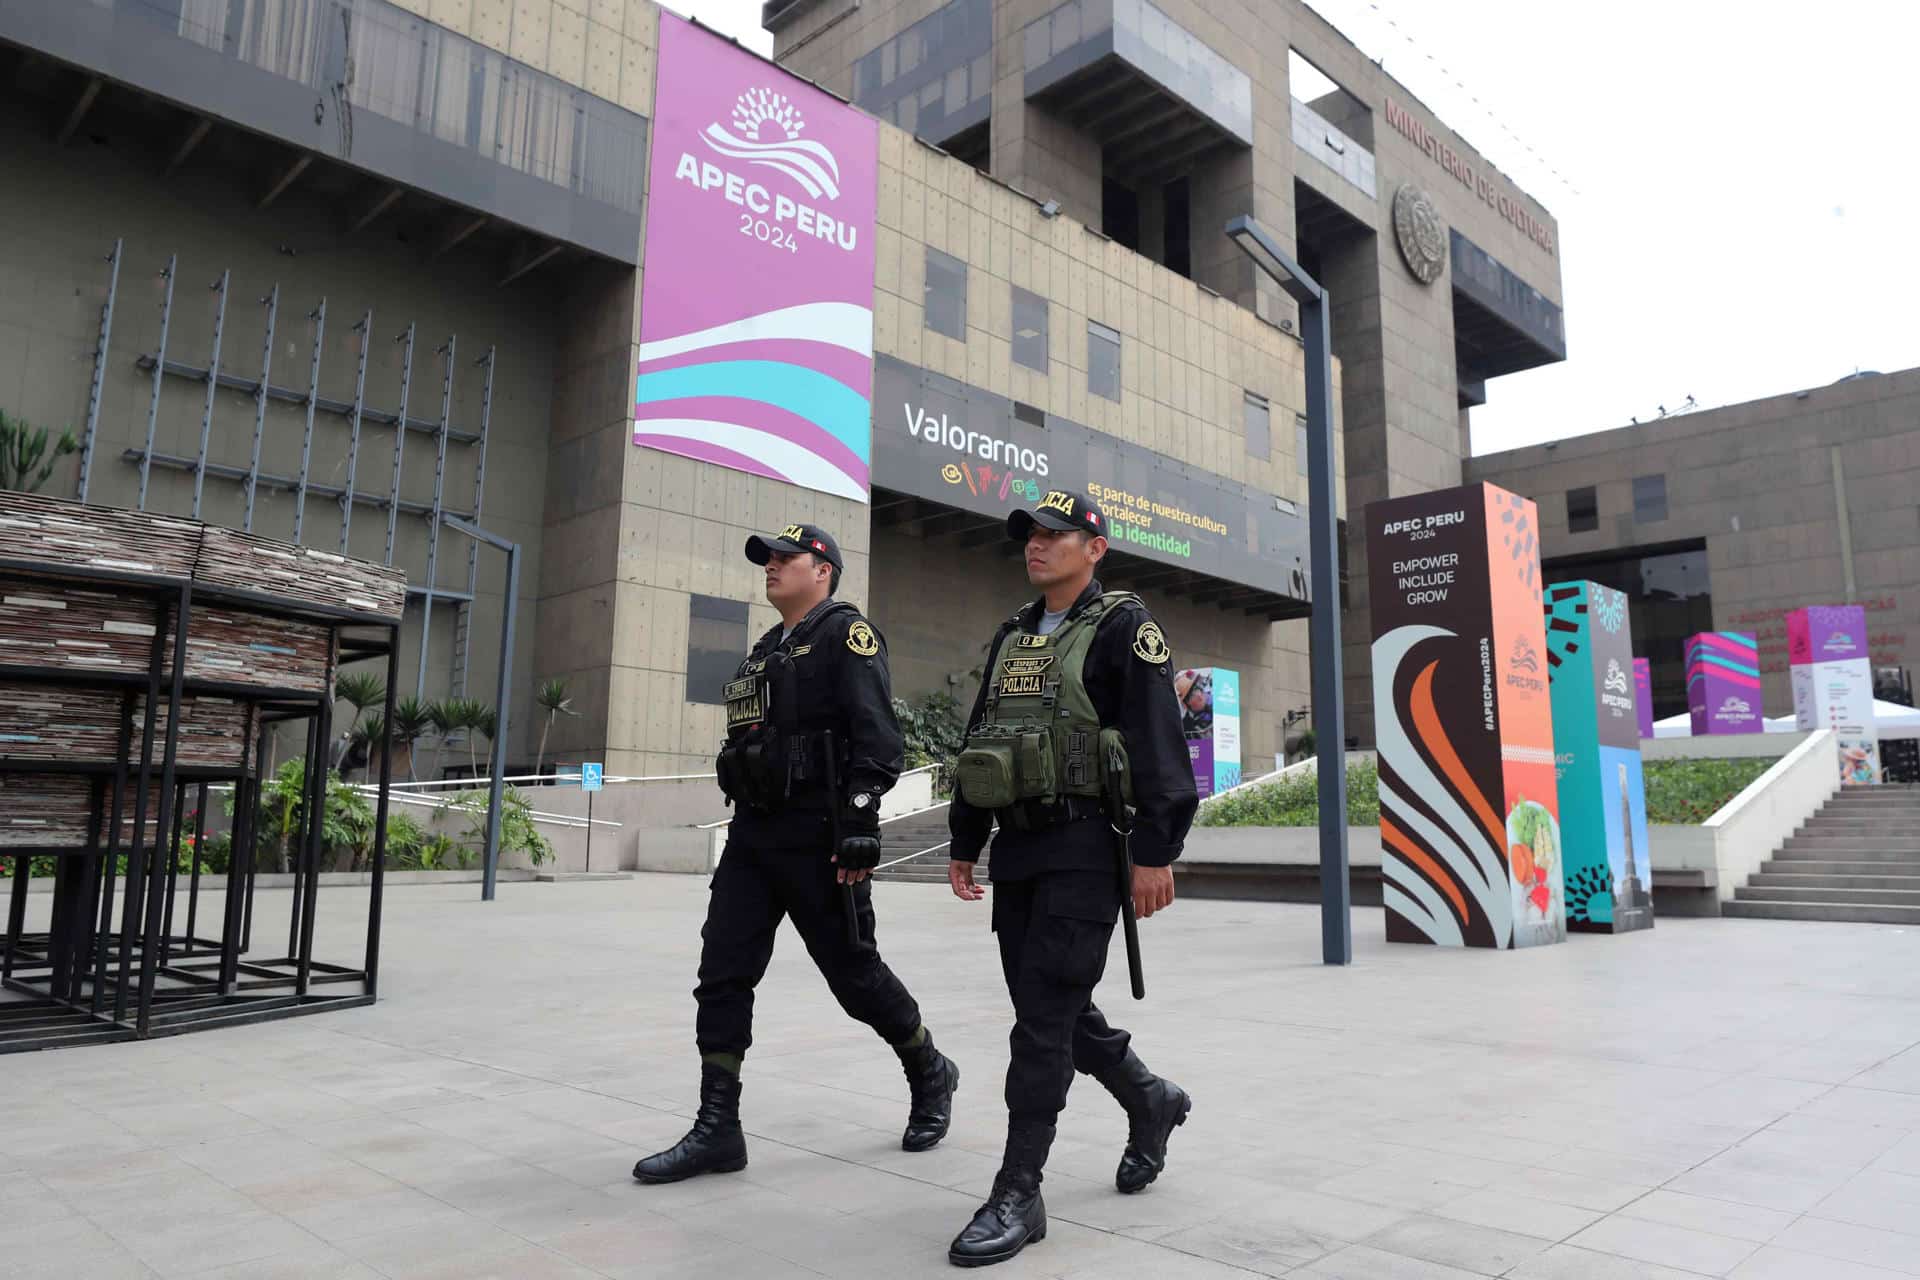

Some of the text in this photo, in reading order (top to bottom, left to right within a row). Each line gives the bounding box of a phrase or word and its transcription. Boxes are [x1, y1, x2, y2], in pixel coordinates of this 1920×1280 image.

[1385, 97, 1553, 255] MINISTERIO DE CULTURA
[676, 152, 857, 251] APEC PERU
[740, 213, 798, 253] 2024
[904, 403, 1049, 476] Valorarnos
[1088, 482, 1227, 536] es parte de nuestra cultura
[1384, 510, 1464, 535] APEC PERU
[1110, 518, 1191, 557] la identidad
[1410, 529, 1436, 541] 2024
[1393, 553, 1459, 574] EMPOWER
[1399, 570, 1455, 590] INCLUDE
[1407, 588, 1448, 605] GROW
[1002, 676, 1040, 693] POLICIA
[1480, 638, 1495, 730] #APECPeru2024
[728, 695, 760, 723] POLICIA
